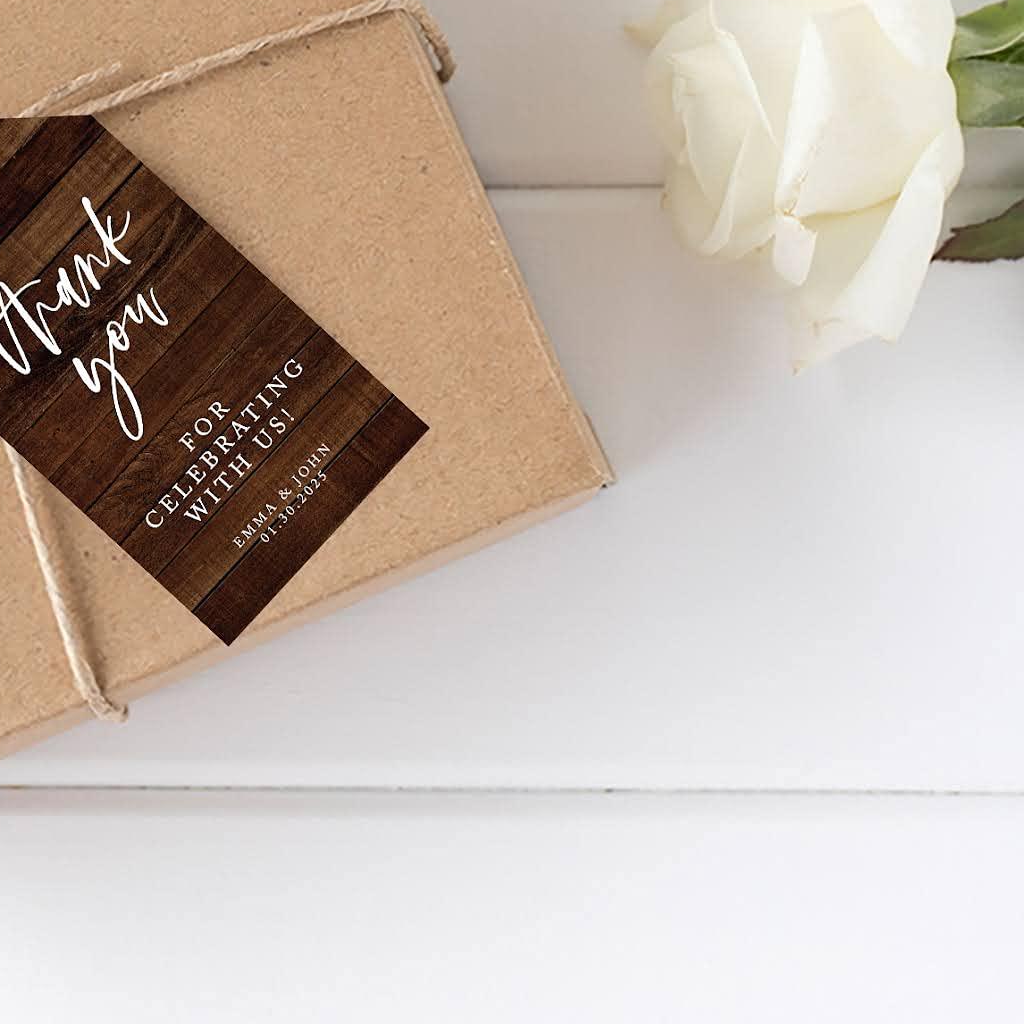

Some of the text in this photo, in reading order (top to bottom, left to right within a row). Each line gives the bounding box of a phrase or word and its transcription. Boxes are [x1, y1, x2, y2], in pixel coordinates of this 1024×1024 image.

[72, 288, 169, 441] you
[146, 359, 303, 528] CELEBRATING
[179, 402, 231, 453] FOR
[184, 408, 295, 521] WITH US!
[232, 443, 331, 549] EMMA & JOHN
[260, 470, 327, 543] 01.30.2025
